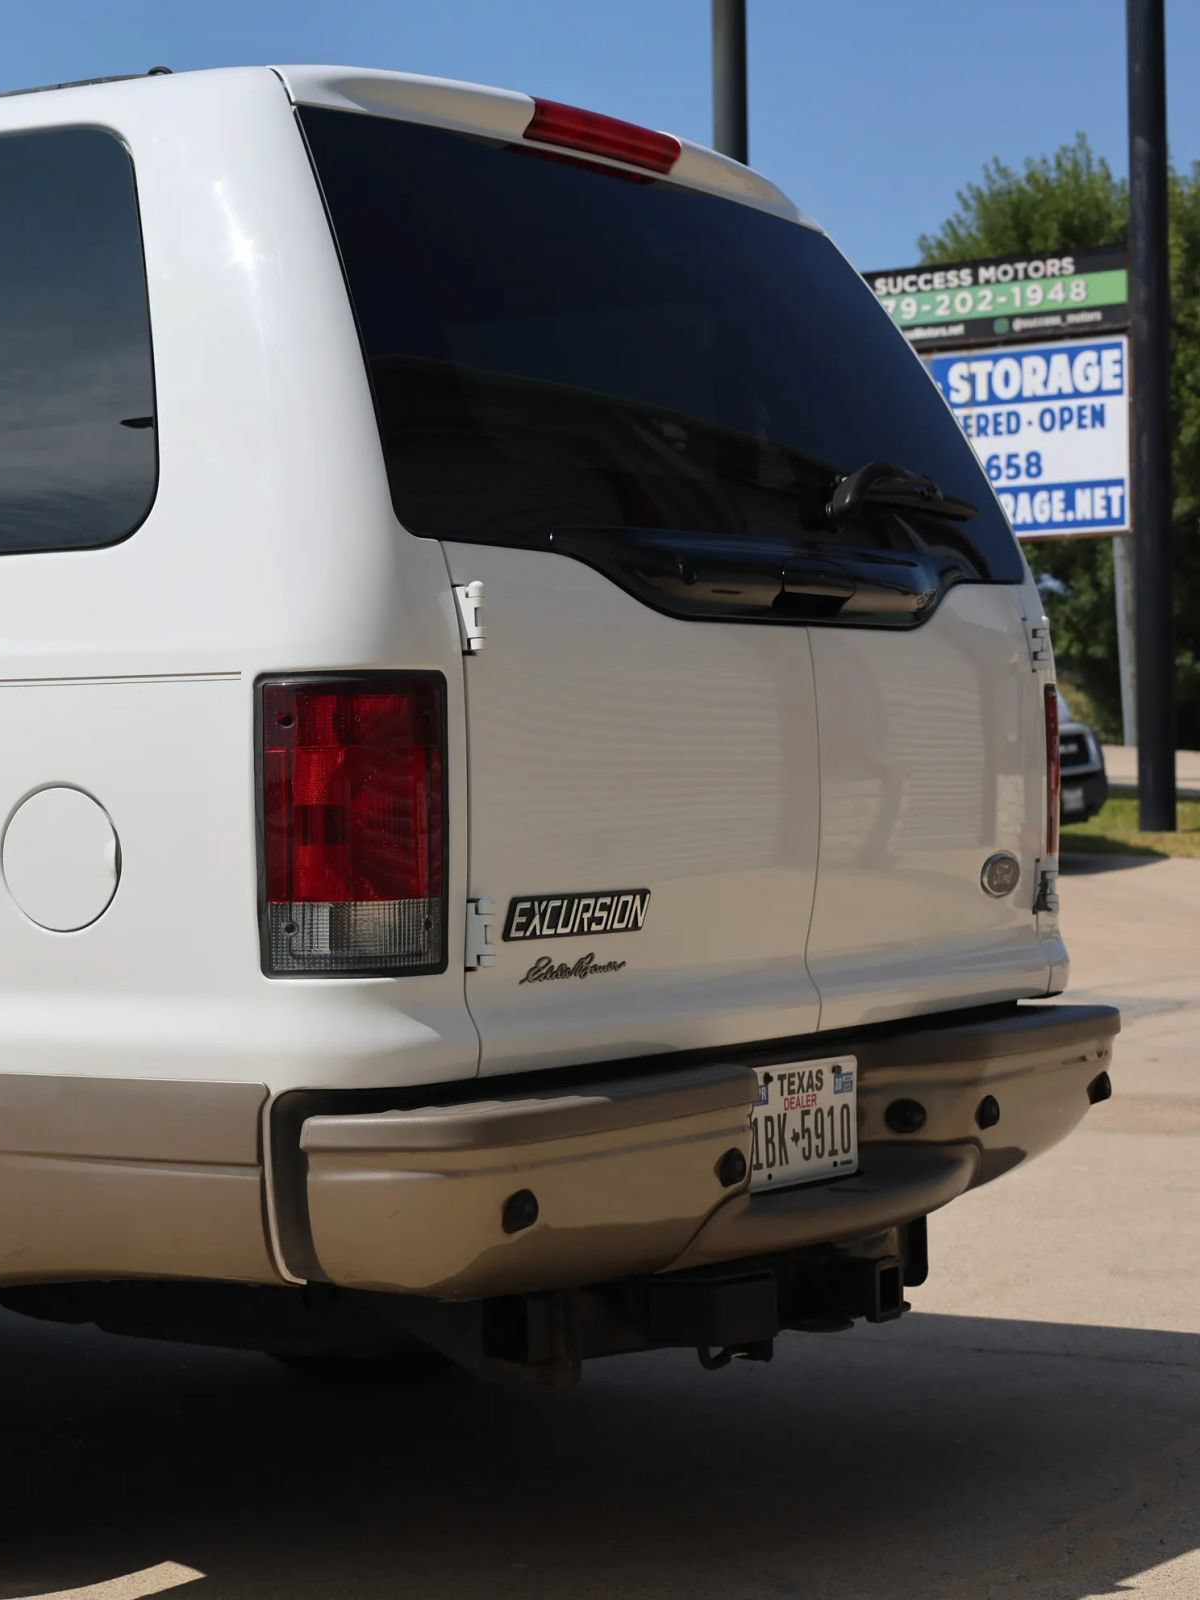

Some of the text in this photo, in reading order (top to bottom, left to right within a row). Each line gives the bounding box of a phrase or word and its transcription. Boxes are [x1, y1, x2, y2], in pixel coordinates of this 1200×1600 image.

[874, 256, 1075, 296] SUCCESS MOTORS
[947, 348, 1122, 404] STORAGE
[1039, 403, 1106, 433] OPEN
[986, 451, 1043, 481] 658
[999, 486, 1124, 525] RAGE.NET
[509, 894, 650, 938] EXCURSION
[777, 1068, 824, 1096] TEXAS
[783, 1093, 817, 1111] DEALER
[800, 1103, 851, 1161] 5910
